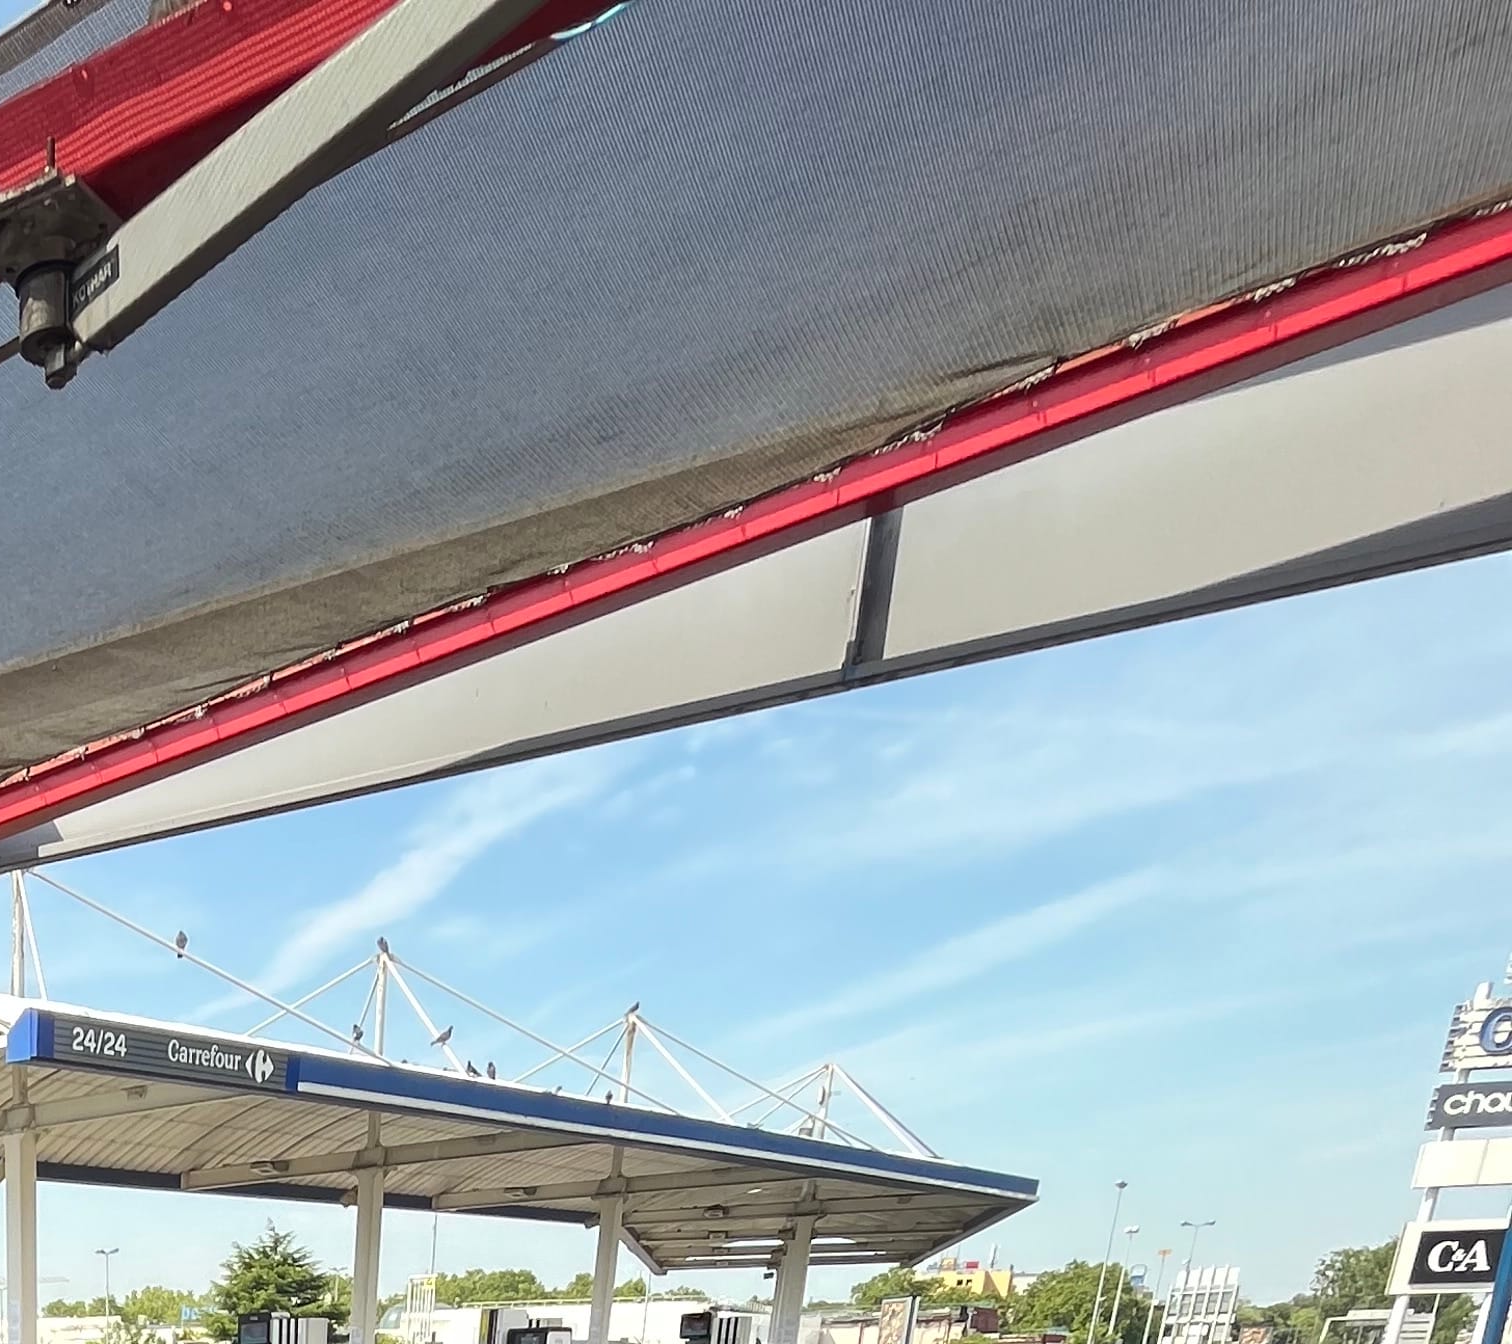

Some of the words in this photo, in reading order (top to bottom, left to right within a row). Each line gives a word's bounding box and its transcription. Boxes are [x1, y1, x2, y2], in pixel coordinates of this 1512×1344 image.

[71, 1026, 128, 1058] 24/24
[167, 1038, 242, 1071] Carrefour
[1443, 1090, 1512, 1115] cha
[1427, 1239, 1491, 1273] C&A
